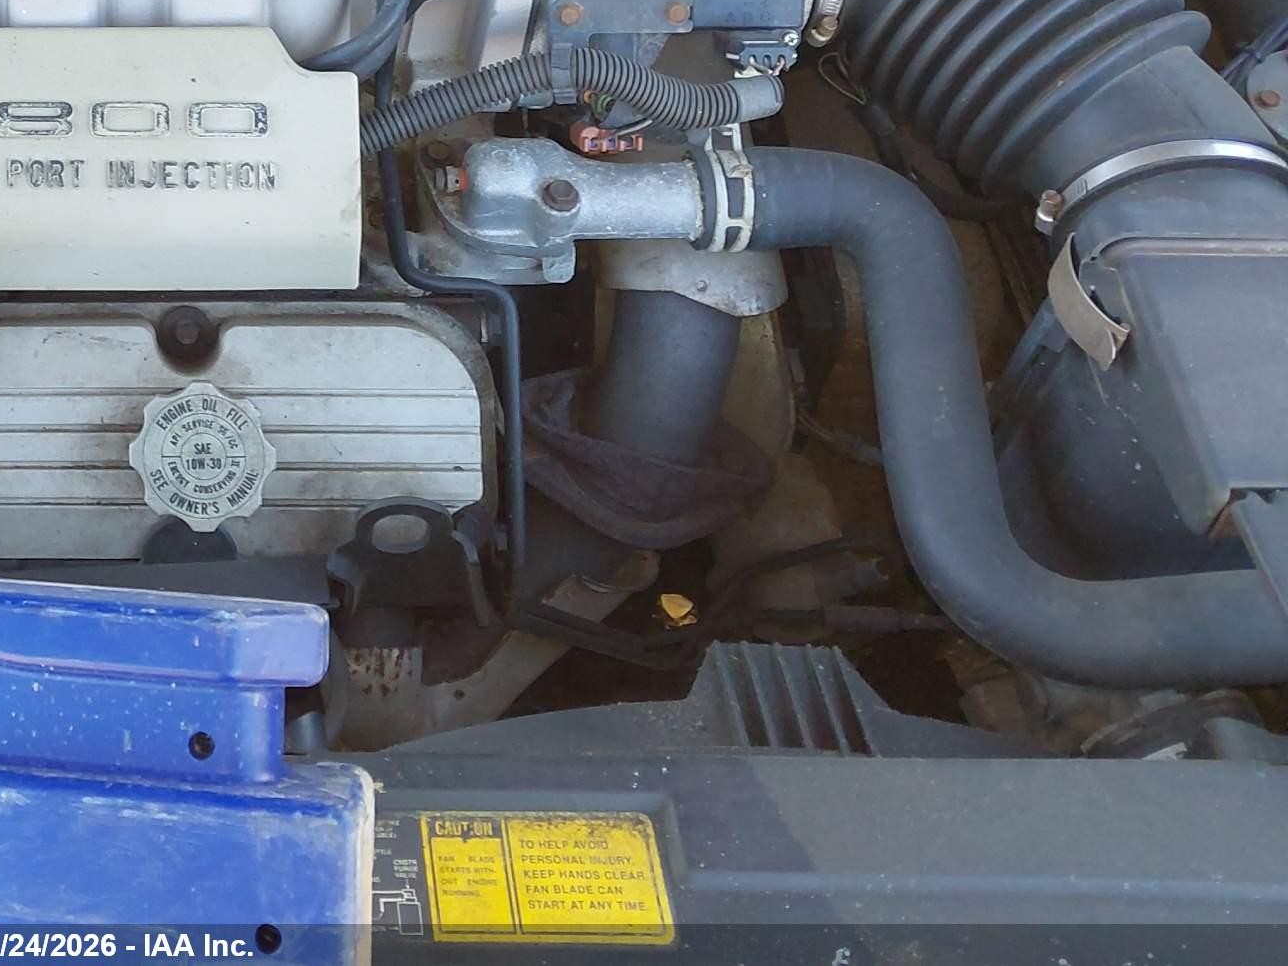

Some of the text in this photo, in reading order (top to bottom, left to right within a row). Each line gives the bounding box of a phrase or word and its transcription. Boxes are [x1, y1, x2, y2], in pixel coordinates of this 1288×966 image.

[6, 157, 85, 189] PORT
[106, 159, 280, 190] INJECTION
[156, 398, 249, 431] ENGINE OIL FILL
[169, 432, 182, 447] API
[182, 418, 215, 433] SERVICE
[193, 442, 212, 455] SAE
[185, 457, 223, 471] 10W-30
[167, 461, 191, 489] ENERGY
[193, 470, 237, 494] CONSERVING
[150, 468, 260, 516] SEE OWNER'S MANUAL
[520, 839, 609, 850] TO HELP AVOID
[520, 855, 585, 865] PERSONAL
[523, 870, 555, 879] KEEP
[559, 870, 601, 880] HANDS
[525, 885, 624, 895] FAN BLADE CAN
[527, 899, 566, 910] START
[570, 900, 585, 910] AT
[588, 900, 613, 910] ANY
